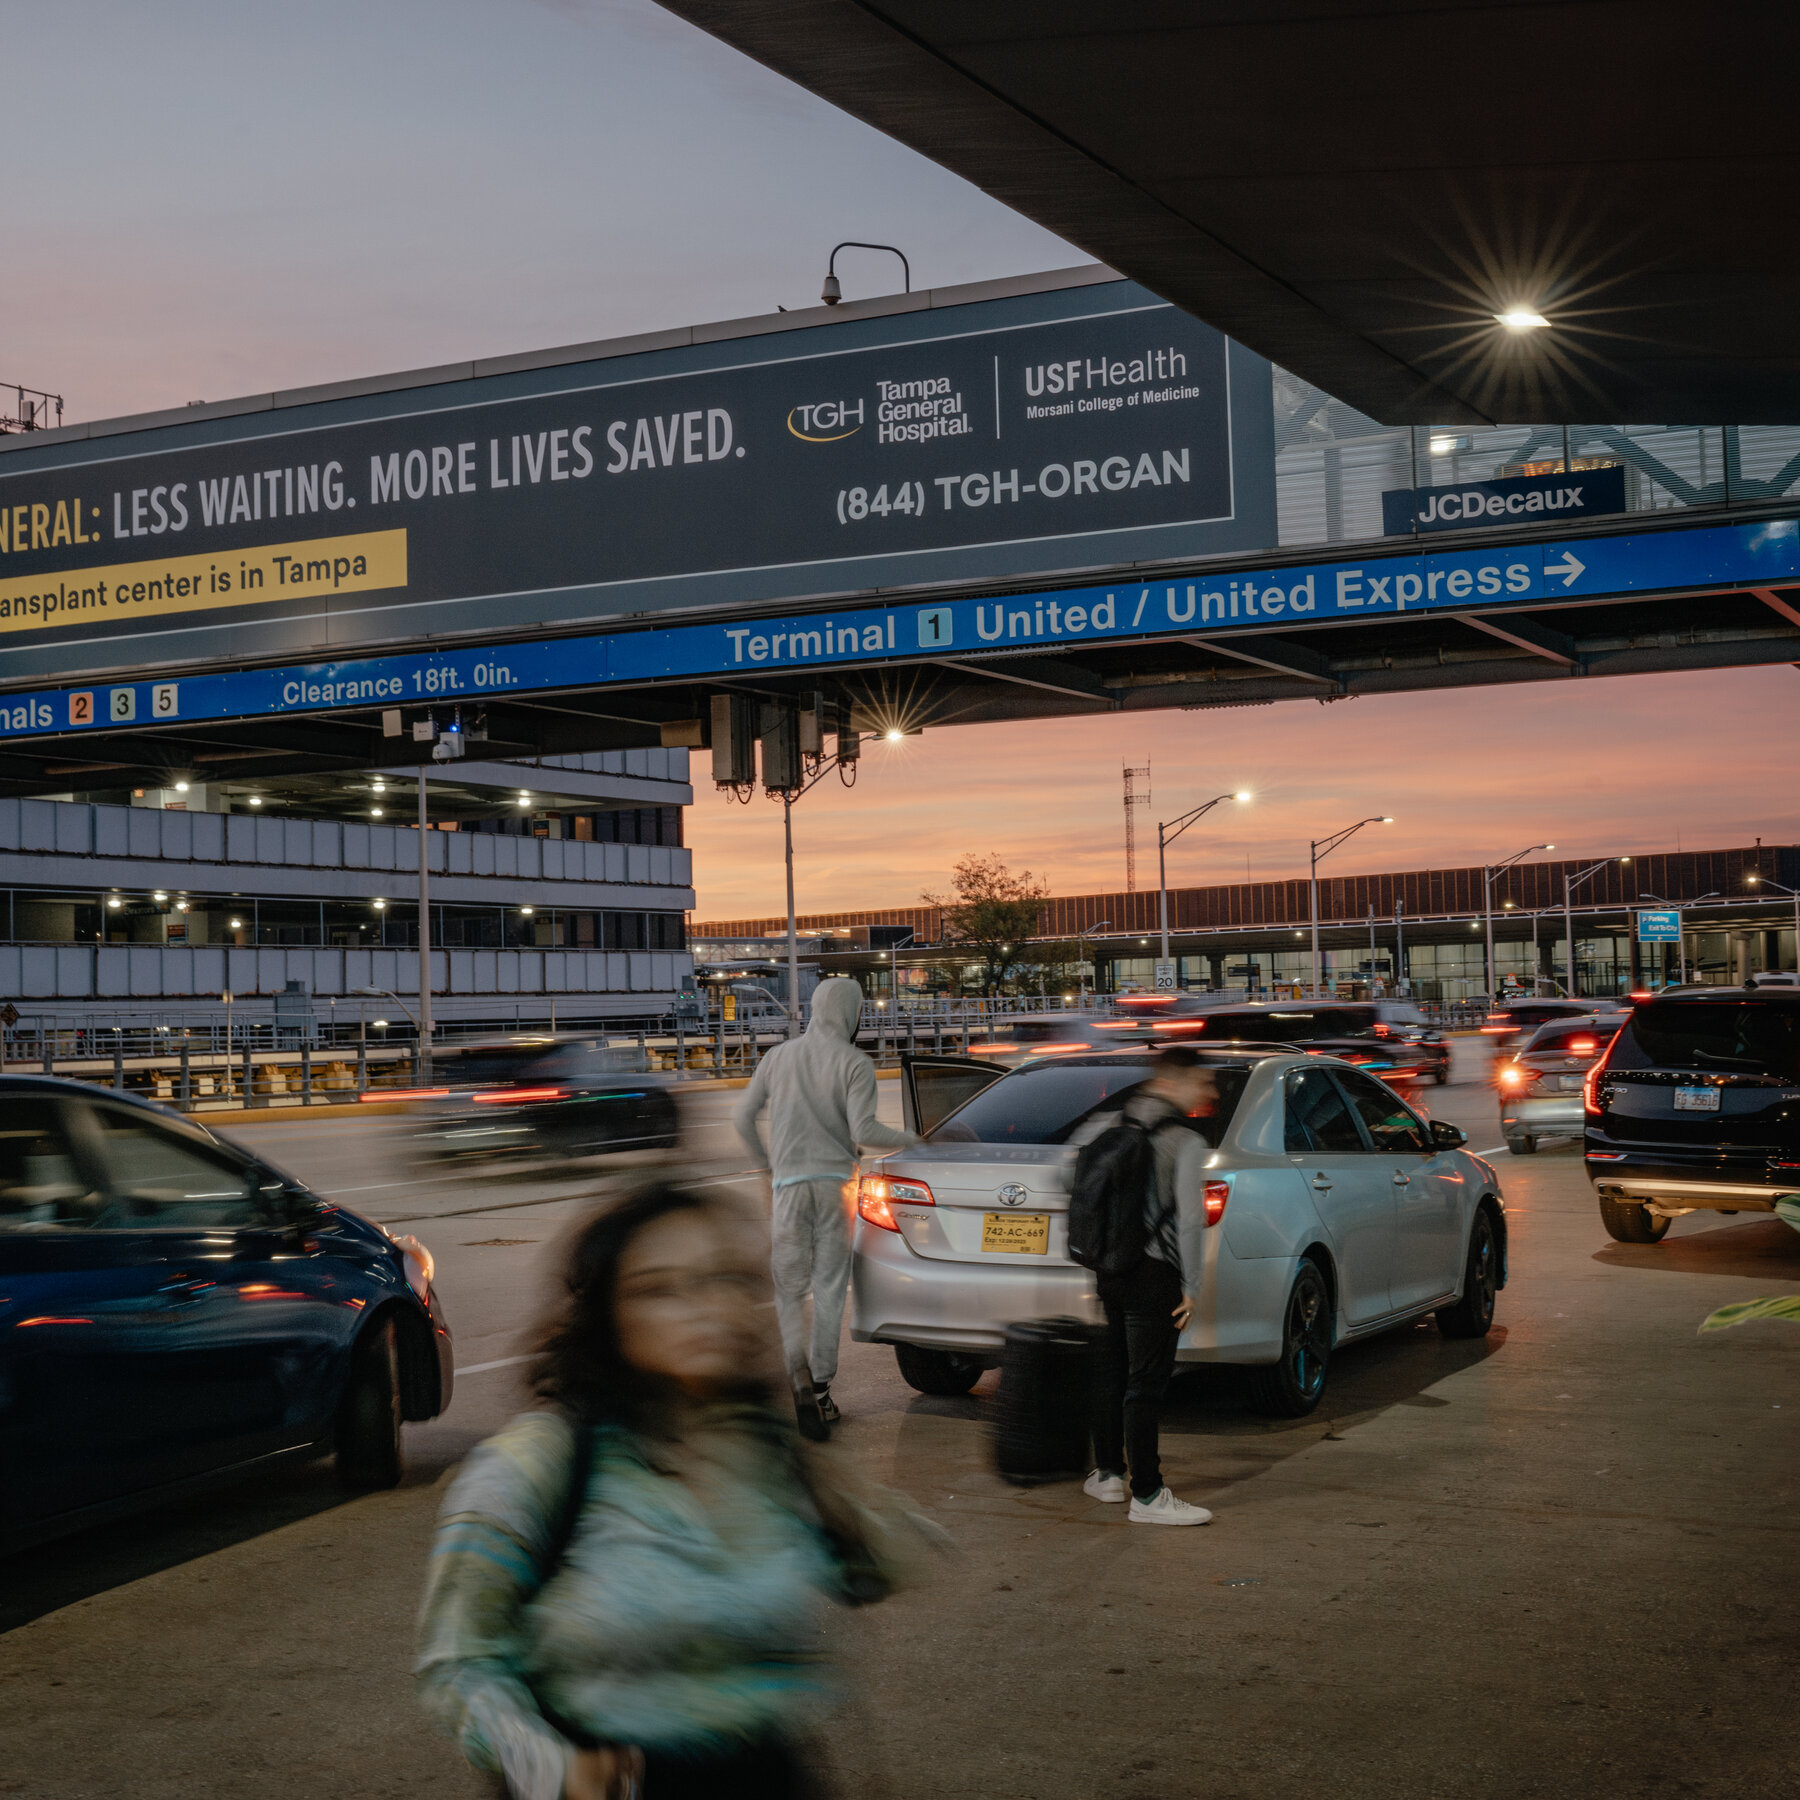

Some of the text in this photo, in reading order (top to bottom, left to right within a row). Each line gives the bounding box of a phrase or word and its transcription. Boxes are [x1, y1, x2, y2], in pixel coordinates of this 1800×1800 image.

[877, 378, 950, 402] Tampa
[1027, 386, 1200, 419] Morsani College of Medicine
[796, 398, 864, 432] TGH
[878, 393, 961, 423] General
[114, 482, 189, 539] LESS
[199, 461, 356, 527] WAITING.
[370, 442, 477, 504] MORE
[490, 426, 593, 489] LIVES
[606, 408, 746, 474] SAVED.
[836, 448, 1191, 525] (844) TGH-ORGAN
[1419, 487, 1585, 523] JCDecaux
[0, 554, 367, 621] ansplant center is in Tampa
[726, 562, 1531, 663] Terminal 1 United / United Express
[282, 662, 518, 706] Clearance 18ft. 0in.
[75, 697, 87, 719] 2
[117, 693, 129, 716] 3
[159, 689, 171, 711] 5
[1648, 915, 1669, 923] Parking
[1666, 924, 1677, 932] City
[1158, 977, 1172, 987] 20
[985, 1227, 1045, 1238] 742-AC-669
